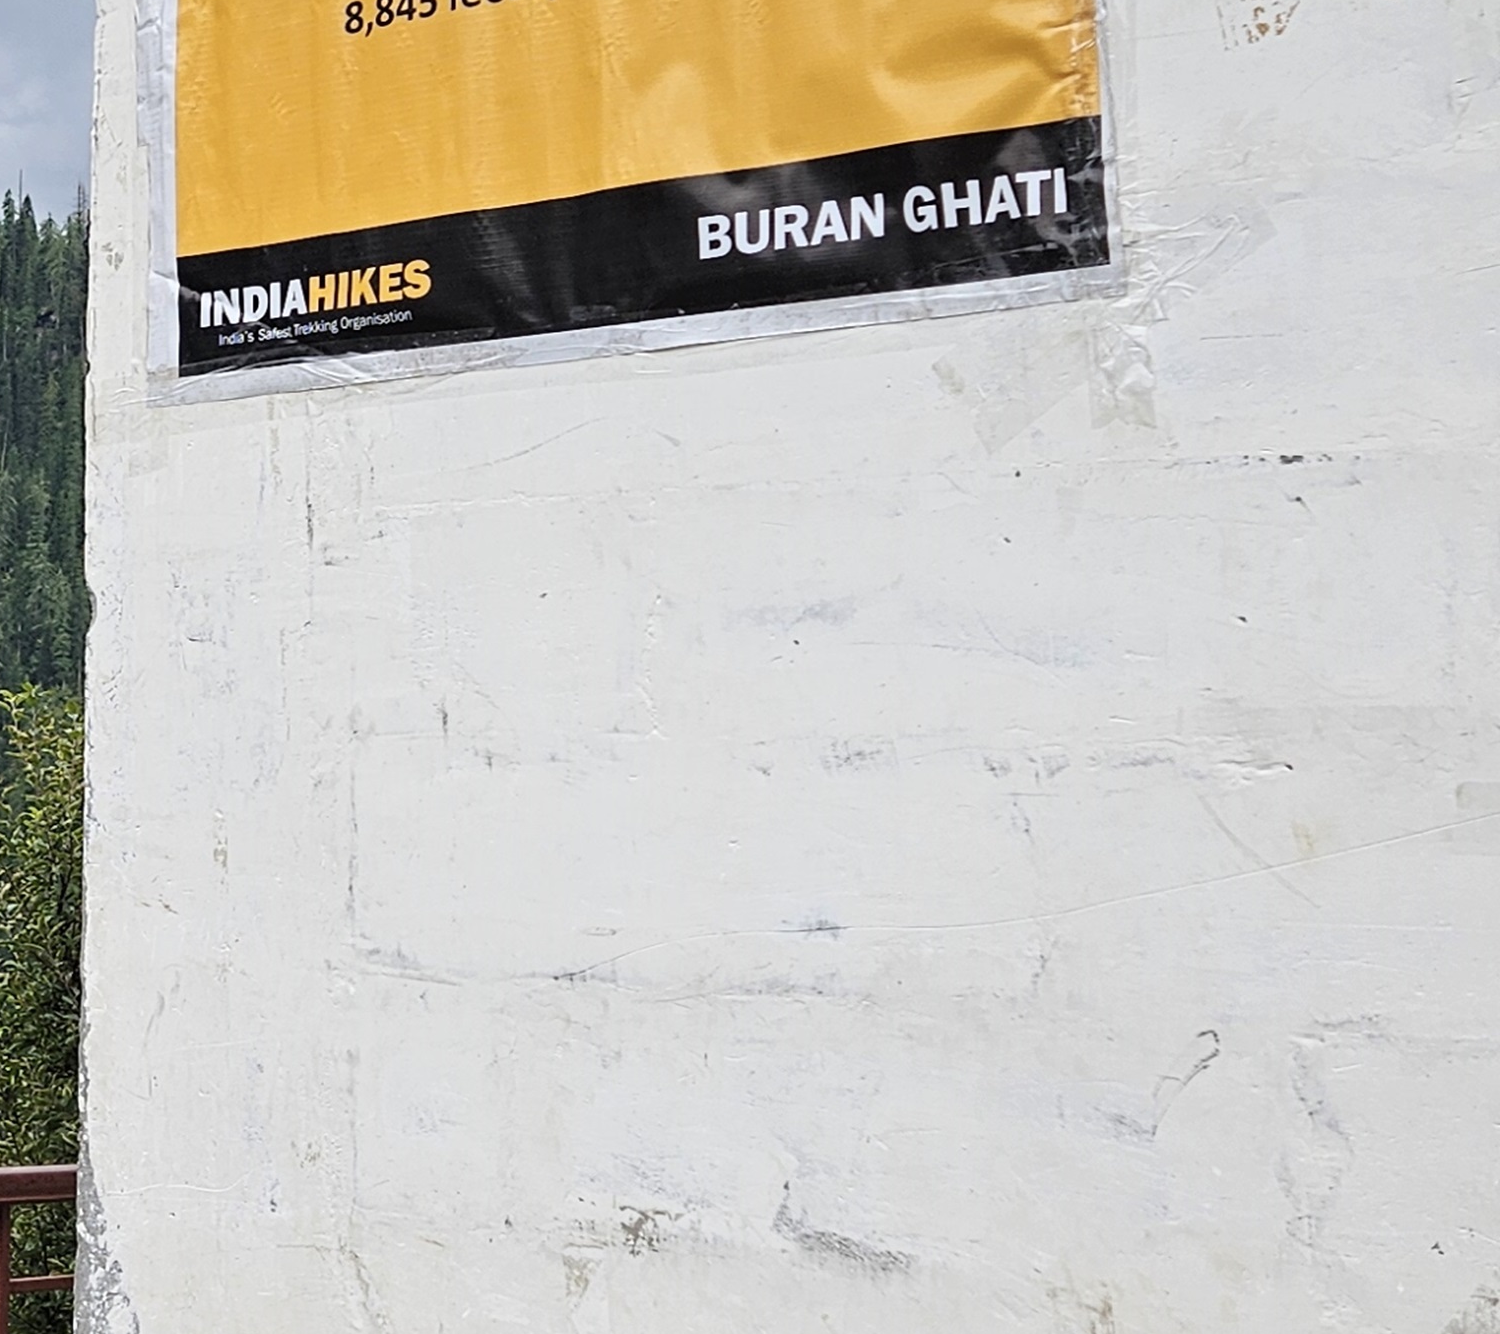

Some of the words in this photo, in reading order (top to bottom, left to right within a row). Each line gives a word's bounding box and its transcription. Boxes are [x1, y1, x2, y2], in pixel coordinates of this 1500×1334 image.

[697, 193, 885, 260] BURAN
[903, 167, 1067, 233] GHATI
[199, 259, 432, 328] INDIAHIKES
[218, 330, 255, 346] India's
[258, 325, 293, 342] Safest
[293, 317, 339, 335] Trekking
[340, 309, 413, 331] Organisation
